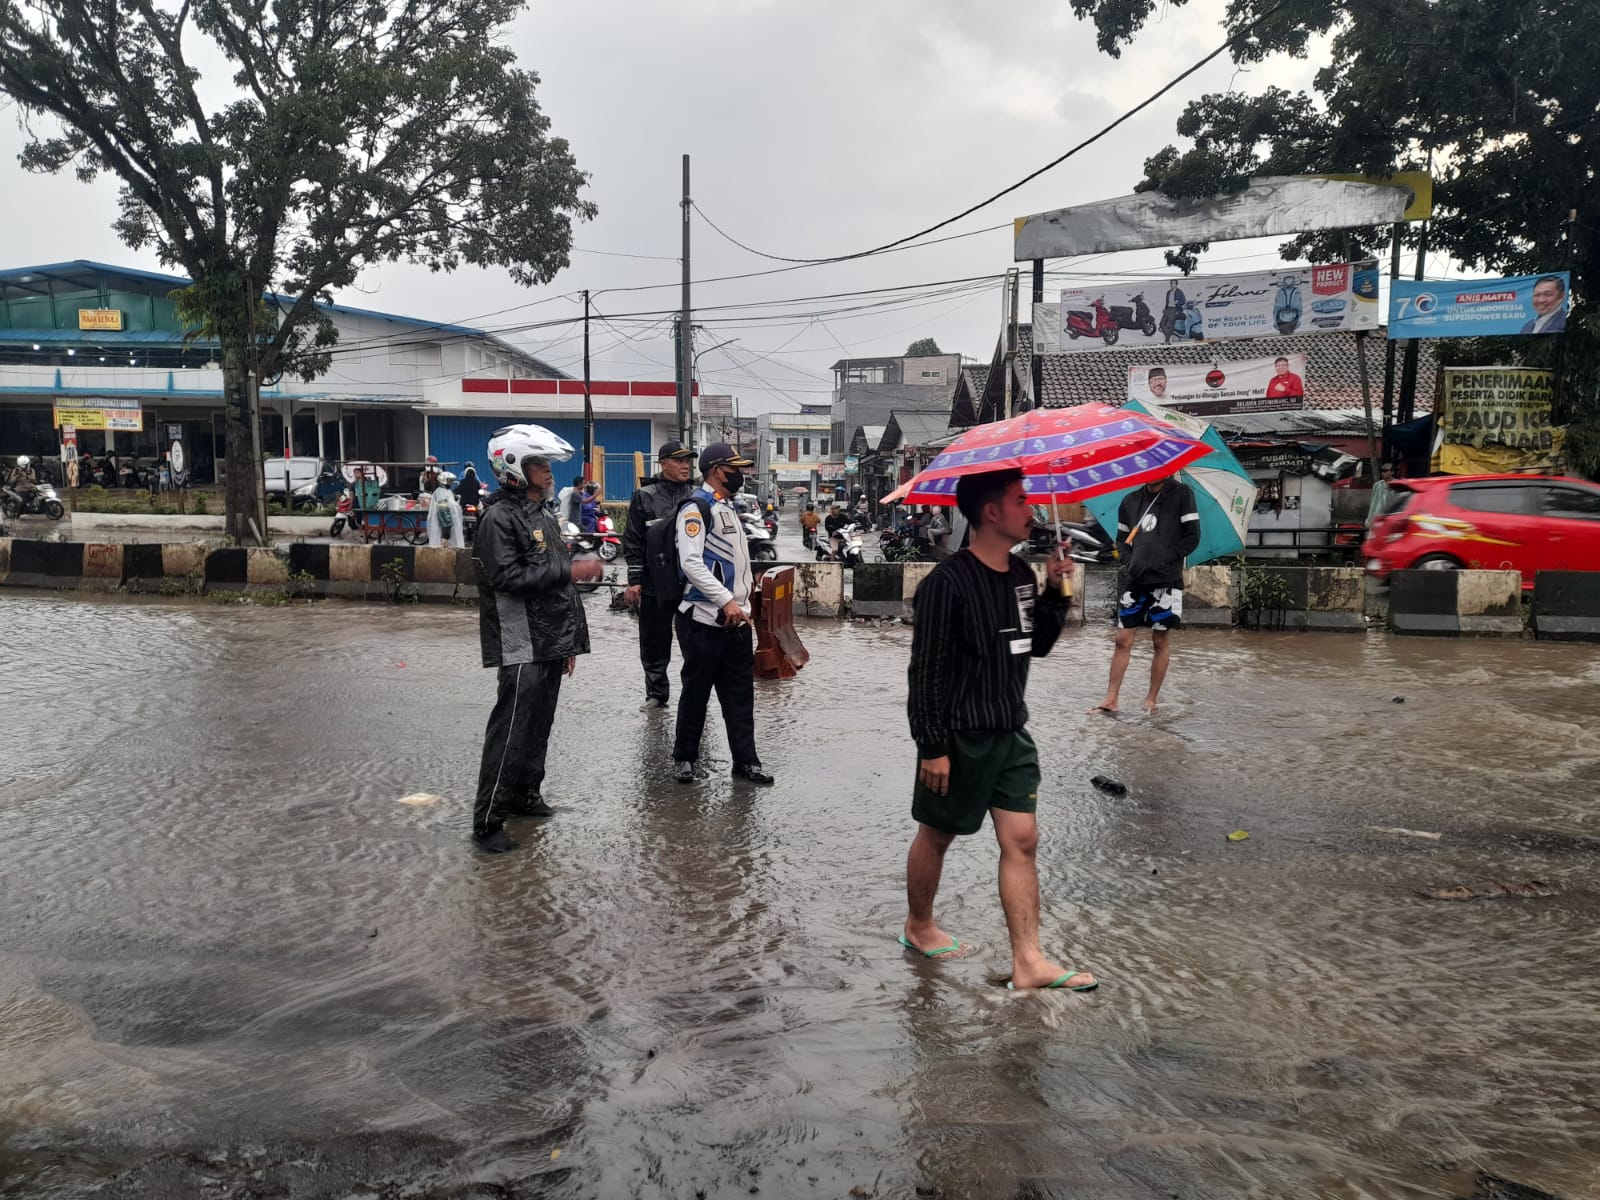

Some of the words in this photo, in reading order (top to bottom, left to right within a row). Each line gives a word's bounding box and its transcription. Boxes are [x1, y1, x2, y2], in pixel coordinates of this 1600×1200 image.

[1317, 269, 1345, 281] NEW
[1316, 279, 1344, 288] PRODUCT
[1458, 295, 1481, 304] ANIS
[1481, 292, 1514, 303] MATTA
[1396, 297, 1411, 320] 7
[1447, 305, 1475, 314] UNTUK
[1475, 303, 1524, 312] INDONESIA
[1244, 313, 1266, 321] LEVEL
[1444, 312, 1500, 321] SUPERPOWER
[1451, 390, 1496, 401] PESERTA
[1498, 390, 1526, 401] DIDIK
[1451, 401, 1479, 409] TAHUN
[1453, 411, 1517, 429] PAUD
